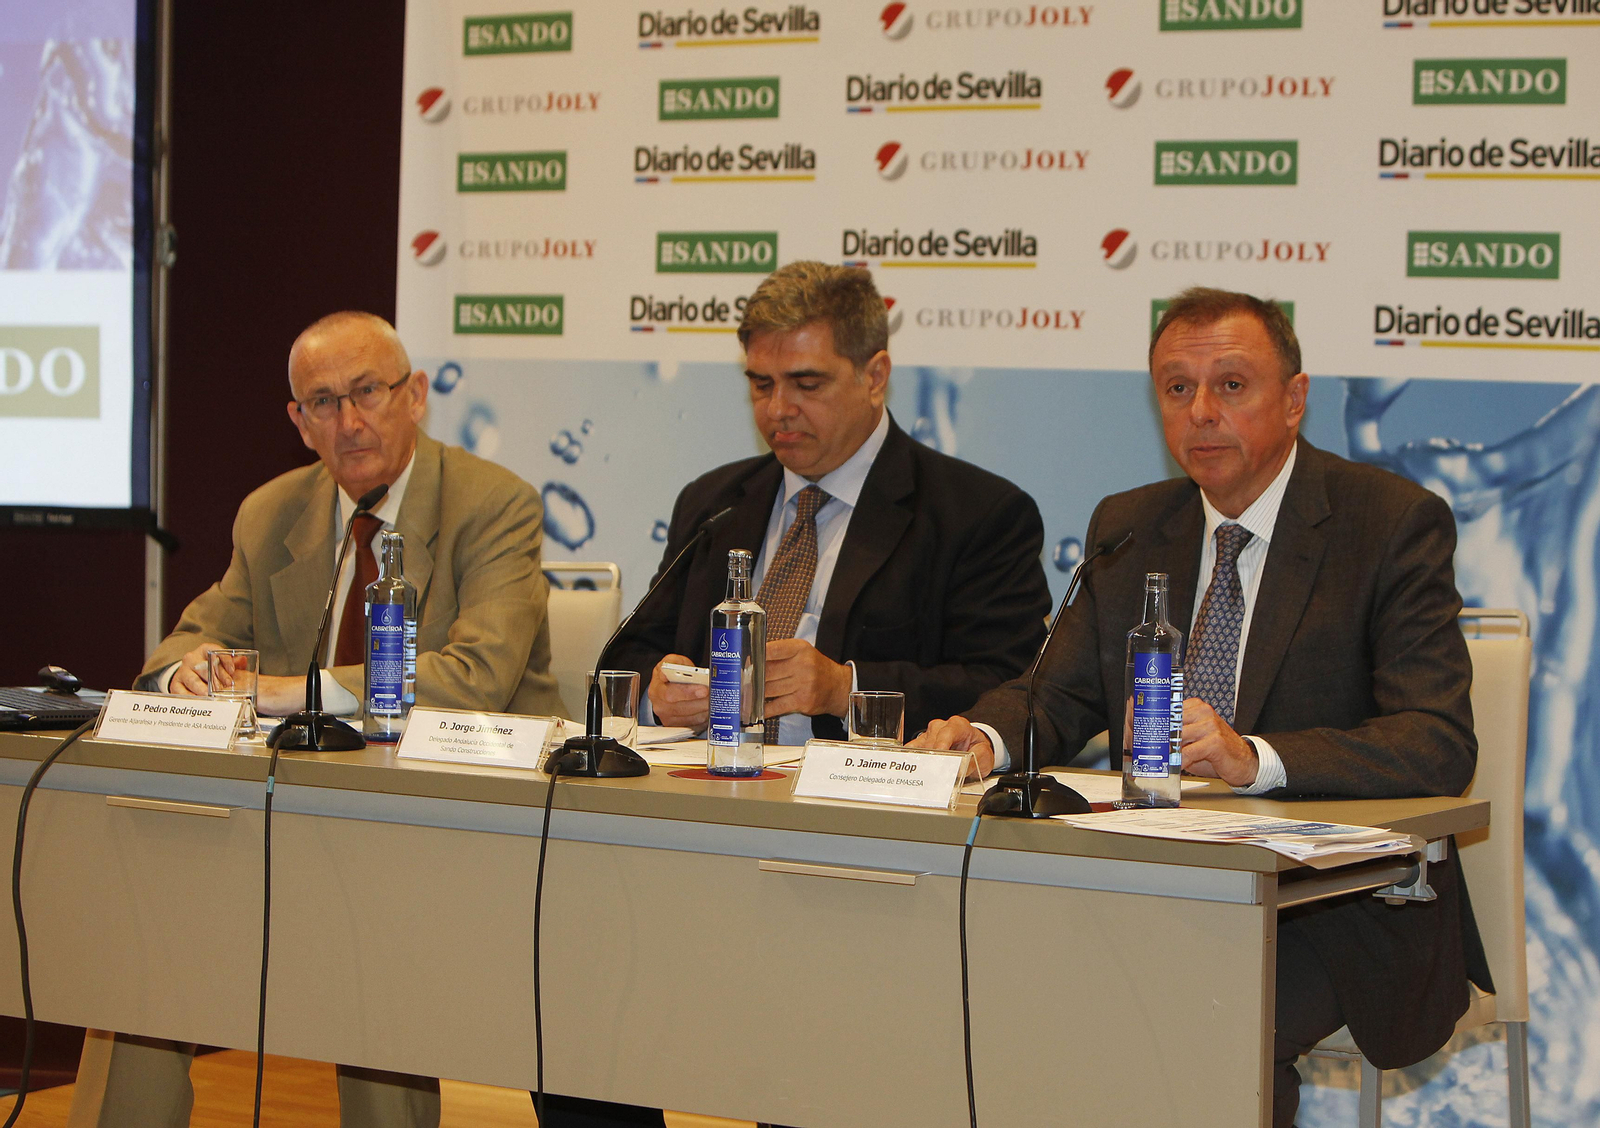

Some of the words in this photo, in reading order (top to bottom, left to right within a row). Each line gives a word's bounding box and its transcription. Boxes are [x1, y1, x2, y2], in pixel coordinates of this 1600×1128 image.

[1180, 0, 1297, 21] SANDO
[1515, 0, 1600, 14] Sevill
[479, 19, 569, 47] SANDO
[639, 10, 707, 37] Diario
[711, 10, 738, 35] de
[743, 6, 820, 35] Sevilla
[847, 75, 919, 102] Diario
[923, 75, 952, 100] de
[958, 72, 1041, 100] Sevilla
[1434, 69, 1560, 94] SANDO
[676, 87, 775, 111] SANDO
[635, 146, 703, 172] Diario
[707, 147, 734, 171] de
[739, 144, 815, 171] Sevilla
[1175, 151, 1292, 175] SANDO
[1380, 139, 1464, 167] Diario
[1469, 139, 1504, 167] de
[1510, 139, 1600, 168] Sevilla
[474, 161, 563, 184] SANDO
[673, 242, 773, 264] SANDO
[843, 230, 914, 257] Diario
[918, 231, 948, 256] de
[954, 230, 1037, 257] Sevilla
[1427, 243, 1554, 268] SANDO
[470, 304, 560, 326] SANDO
[630, 296, 698, 322] Diario
[702, 298, 729, 323] de
[1375, 306, 1460, 335] Diario
[1465, 308, 1499, 336] de
[1506, 308, 1600, 339] Sevilla
[132, 703, 141, 712] D.
[143, 704, 168, 714] Pedro
[169, 706, 212, 718] Rodríguez
[109, 716, 129, 724] Gerente
[158, 719, 184, 728] Presidente
[203, 723, 227, 731] Andalucía
[439, 721, 448, 730] D.
[450, 722, 475, 734] Jorge
[476, 724, 514, 736] Jiménez
[428, 735, 453, 743] Delegado
[453, 737, 478, 746] Andalucía
[440, 745, 457, 753] Sando
[457, 746, 496, 756] Construcciones
[844, 758, 855, 768] D.
[857, 759, 887, 770] Jaime
[888, 761, 918, 773] Palop
[829, 773, 858, 783] Consejero
[858, 775, 886, 784] Delegado
[887, 776, 895, 785] de
[895, 778, 924, 787] EMASESA
